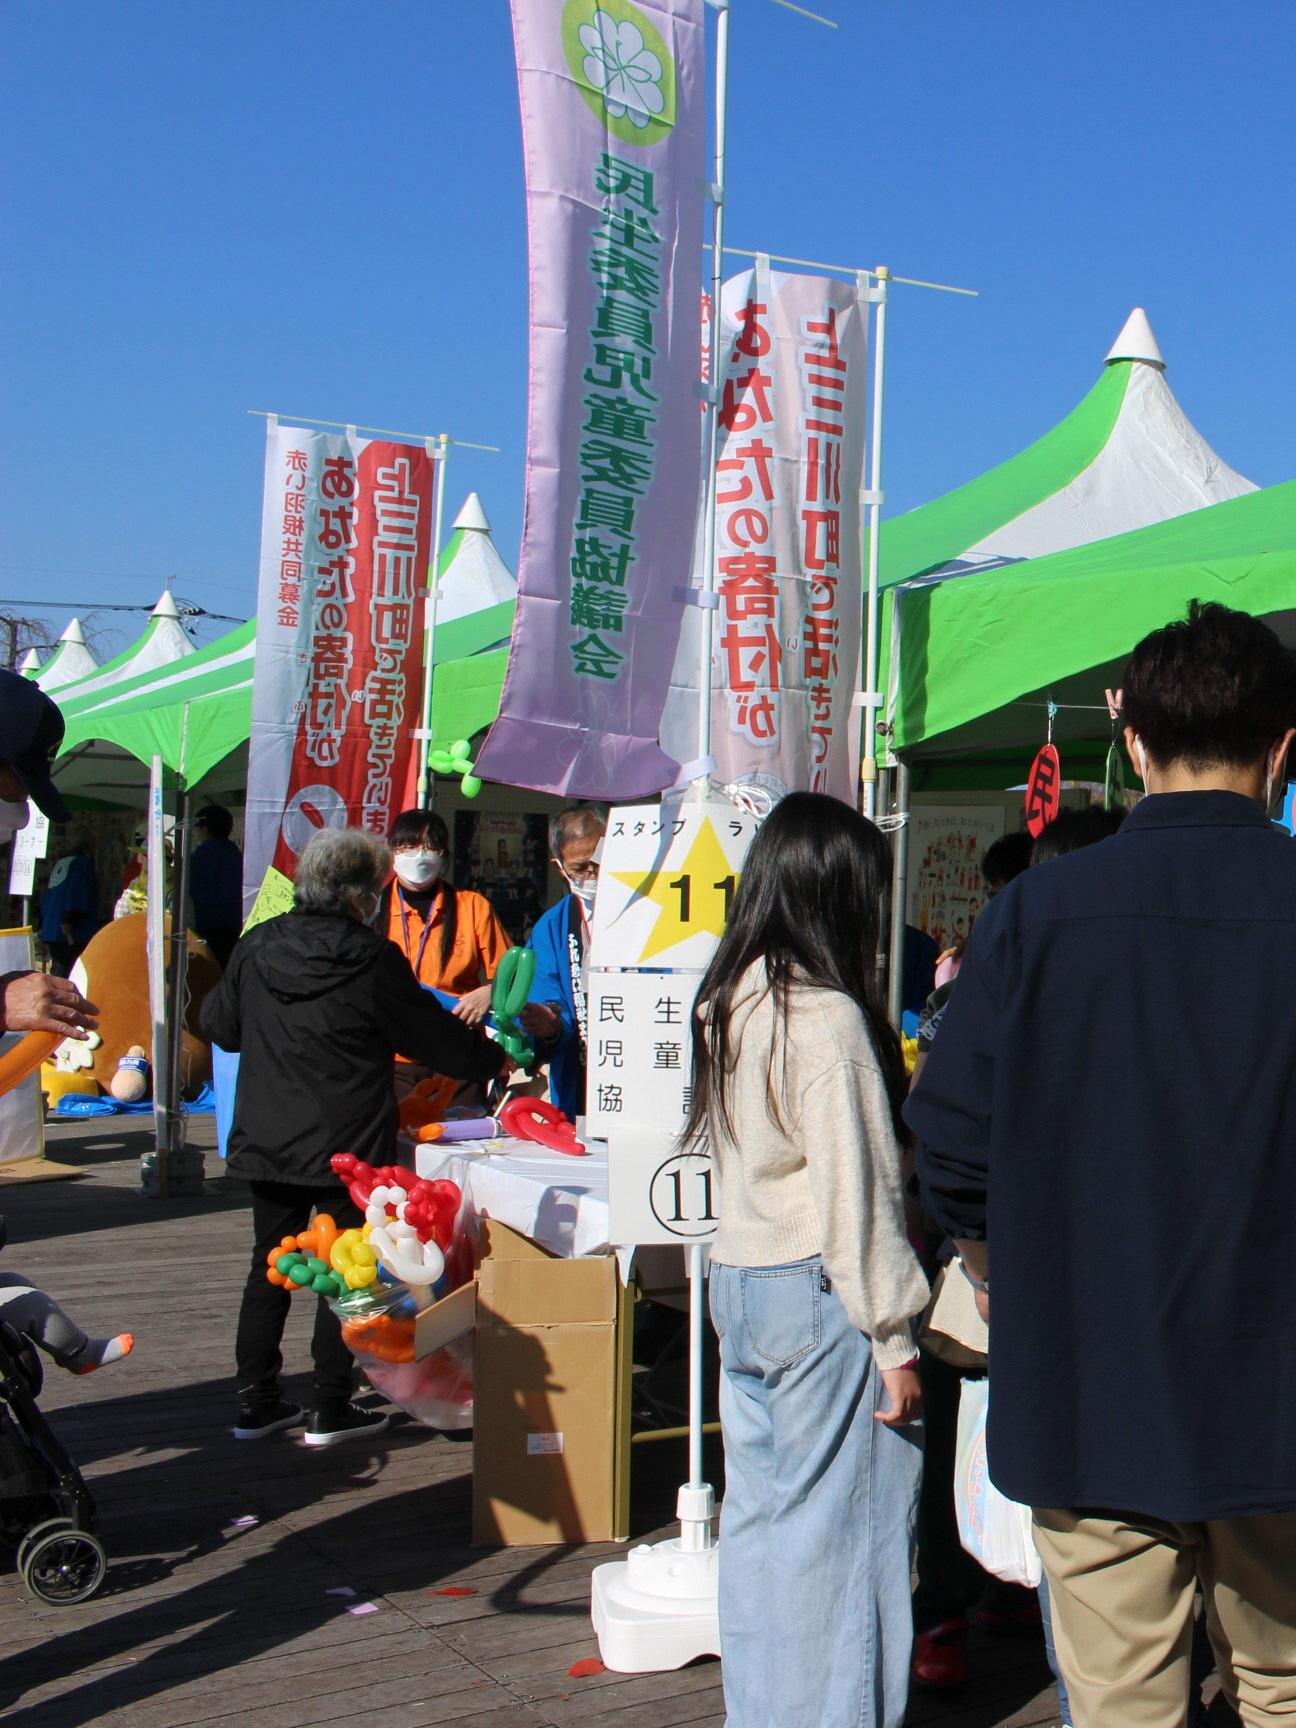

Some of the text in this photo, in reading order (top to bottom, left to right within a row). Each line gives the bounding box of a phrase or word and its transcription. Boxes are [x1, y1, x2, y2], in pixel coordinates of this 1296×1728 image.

[613, 817, 687, 838] スタンプ
[669, 874, 735, 923] 11
